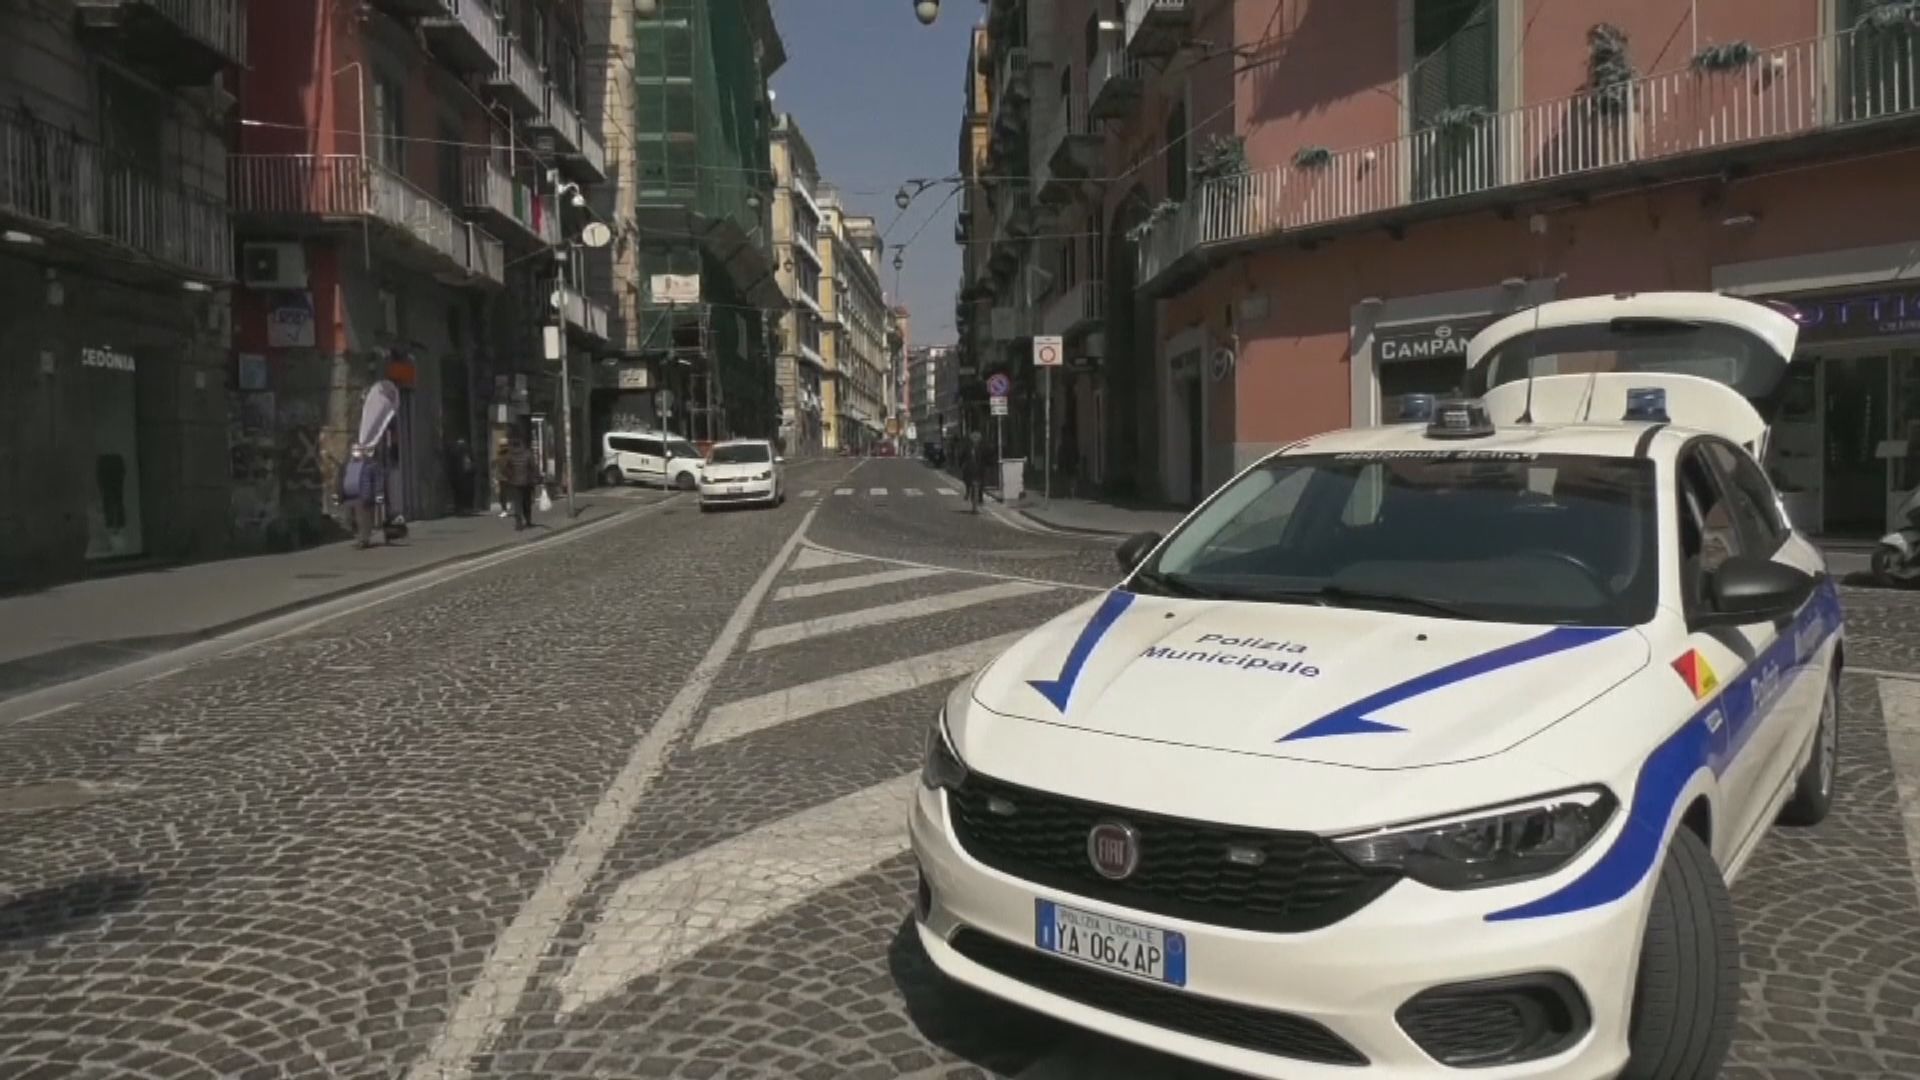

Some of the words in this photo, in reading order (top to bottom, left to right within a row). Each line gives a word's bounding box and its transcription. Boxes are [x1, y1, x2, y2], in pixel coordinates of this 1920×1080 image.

[1194, 633, 1309, 654] Polizia
[1139, 645, 1321, 678] Municipale
[1099, 837, 1125, 865] FIAT
[1056, 922, 1080, 954] YA
[1061, 909, 1101, 930] POLIZIA
[1107, 921, 1154, 942] LOCALE
